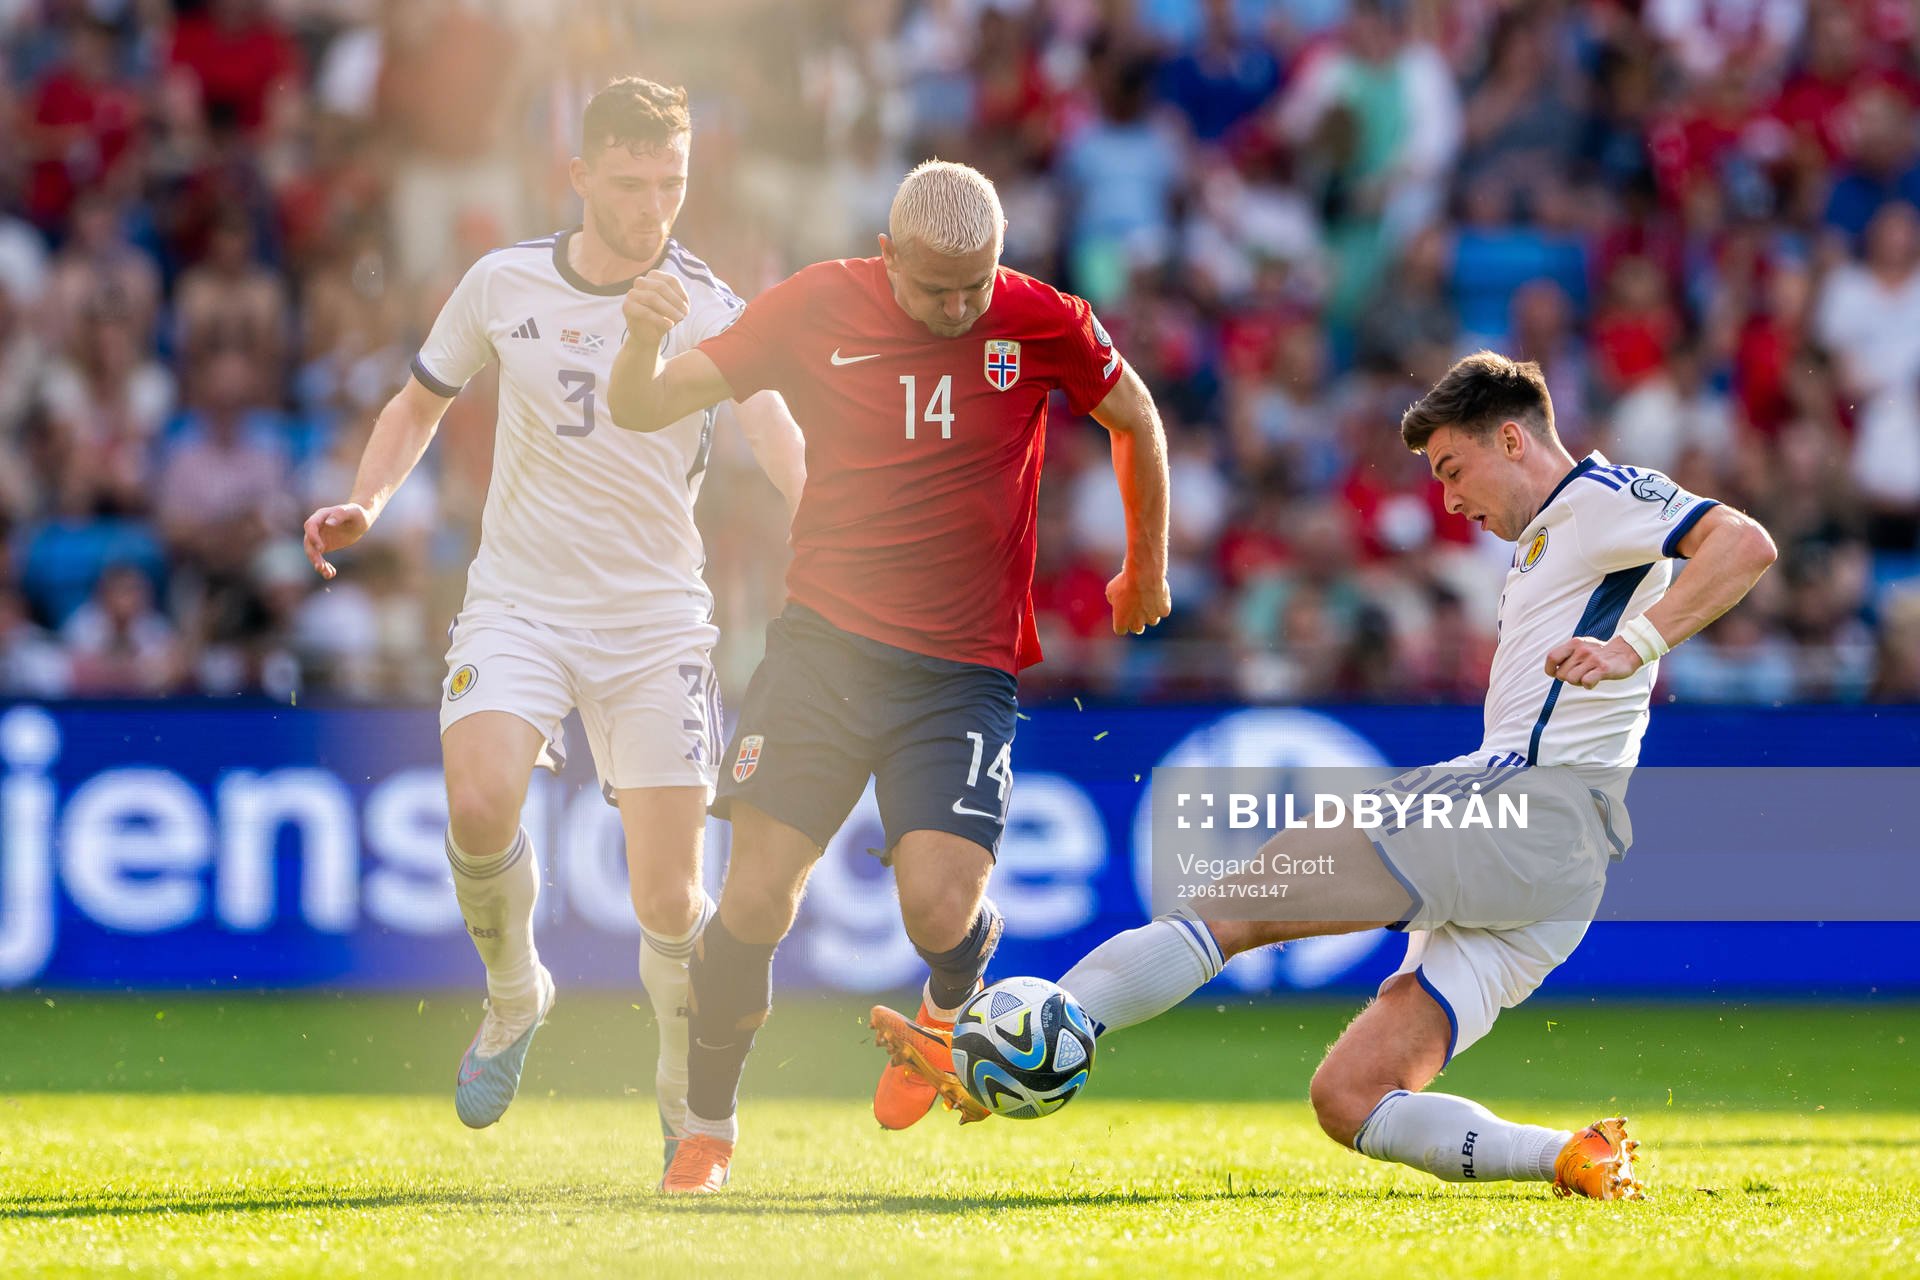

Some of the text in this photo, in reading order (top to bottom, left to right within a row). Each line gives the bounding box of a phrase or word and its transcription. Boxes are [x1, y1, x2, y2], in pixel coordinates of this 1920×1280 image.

[556, 369, 596, 437] 3
[900, 375, 955, 439] 14
[967, 731, 1010, 801] 14
[0, 706, 1108, 992] jensge
[1462, 1131, 1478, 1178] ALBA
